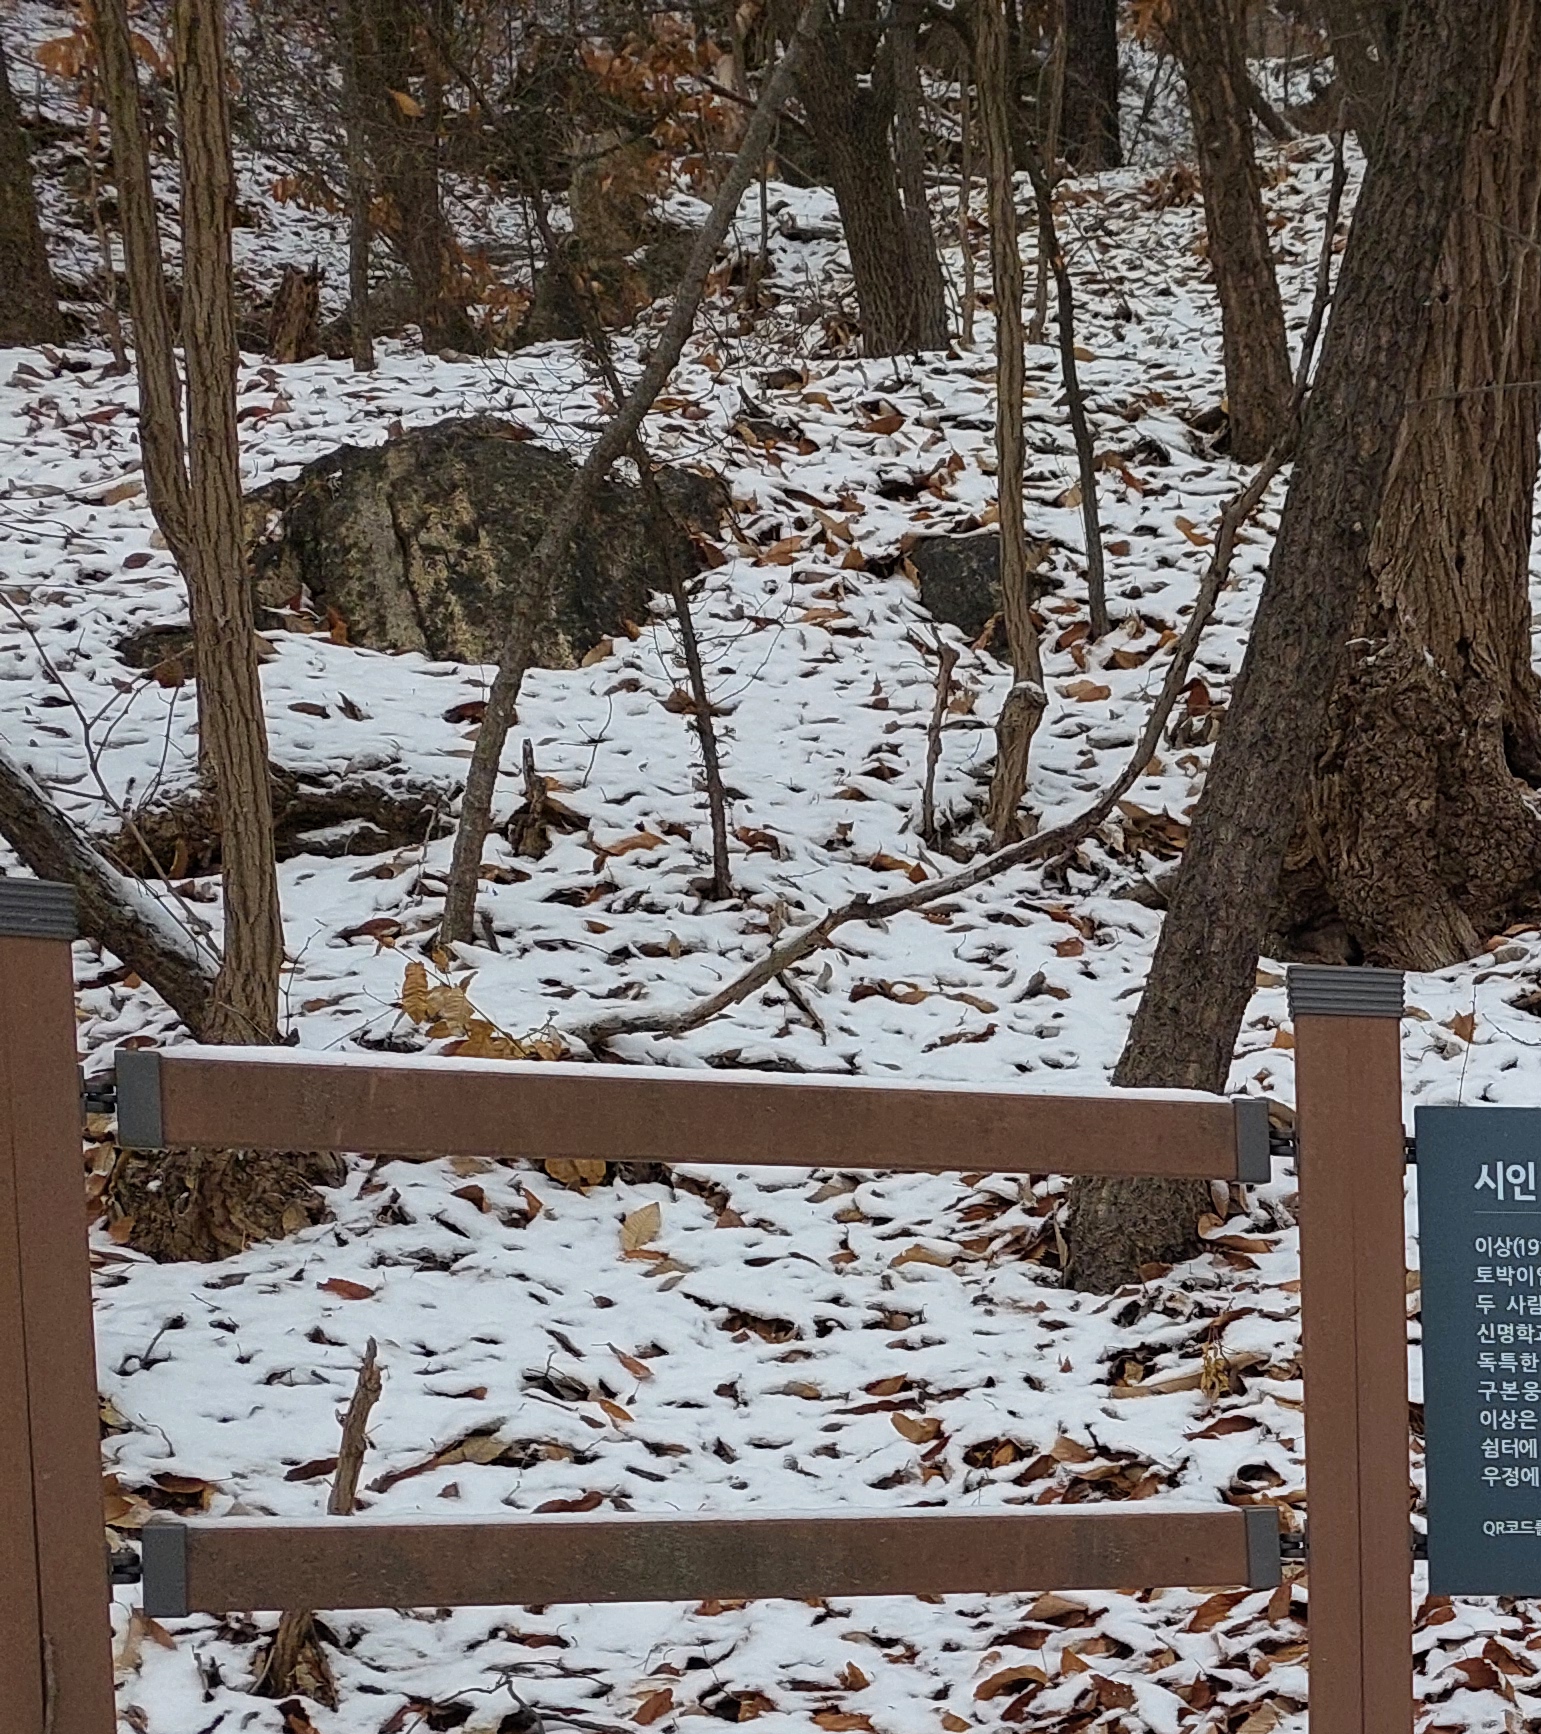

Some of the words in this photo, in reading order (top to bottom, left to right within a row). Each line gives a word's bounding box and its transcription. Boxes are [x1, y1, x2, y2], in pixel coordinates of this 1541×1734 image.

[1473, 1160, 1537, 1202] 시인
[1475, 1294, 1496, 1316] 두
[1476, 1352, 1540, 1374] 독특한
[1479, 1408, 1539, 1431] 이상은
[1480, 1437, 1538, 1459] 쉼터에
[1480, 1466, 1540, 1488] 우정에
